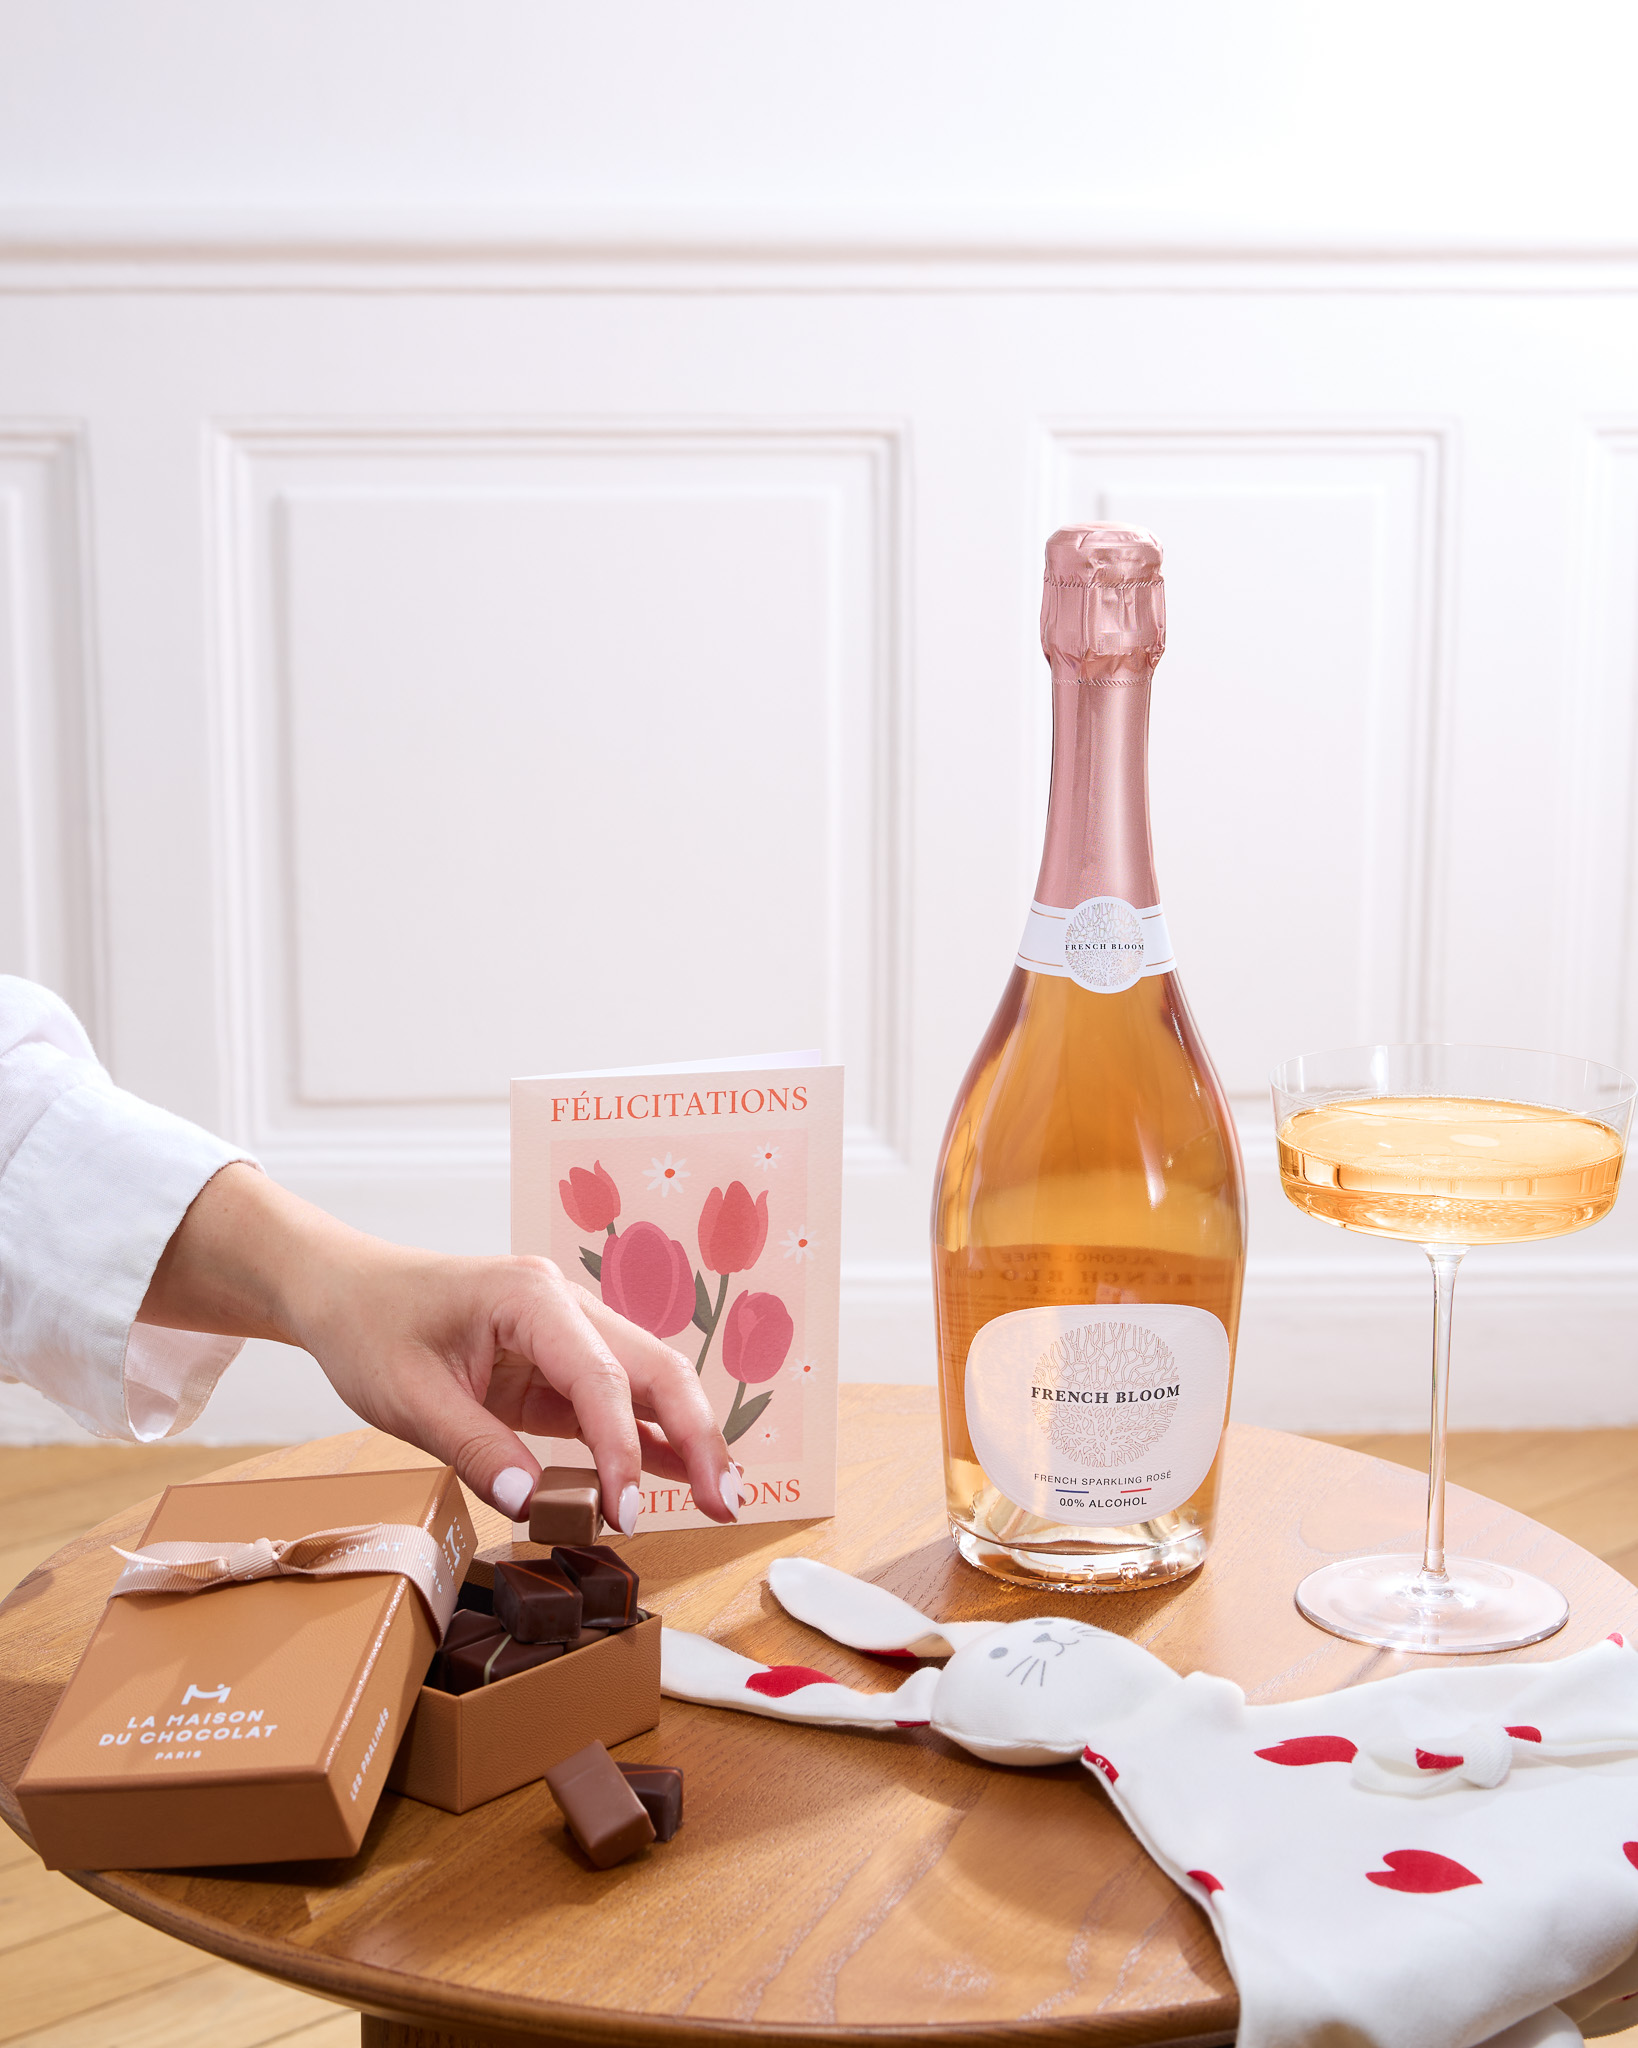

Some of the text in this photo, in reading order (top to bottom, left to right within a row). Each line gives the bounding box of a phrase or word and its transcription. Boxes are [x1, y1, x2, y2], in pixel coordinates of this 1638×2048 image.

[550, 1086, 809, 1122] FÉLICITATIONS
[1031, 1384, 1180, 1404] FRENCH BLOOM
[1034, 1469, 1172, 1486] FRENCH SPARKLING ROSÉ
[1088, 1496, 1148, 1508] ALCOHOL
[127, 1709, 264, 1729] LA MAISON
[98, 1724, 278, 1746] DU CHOCOLAT
[154, 1750, 202, 1761] PARIS
[349, 1707, 390, 1802] LES PRALINÉS
